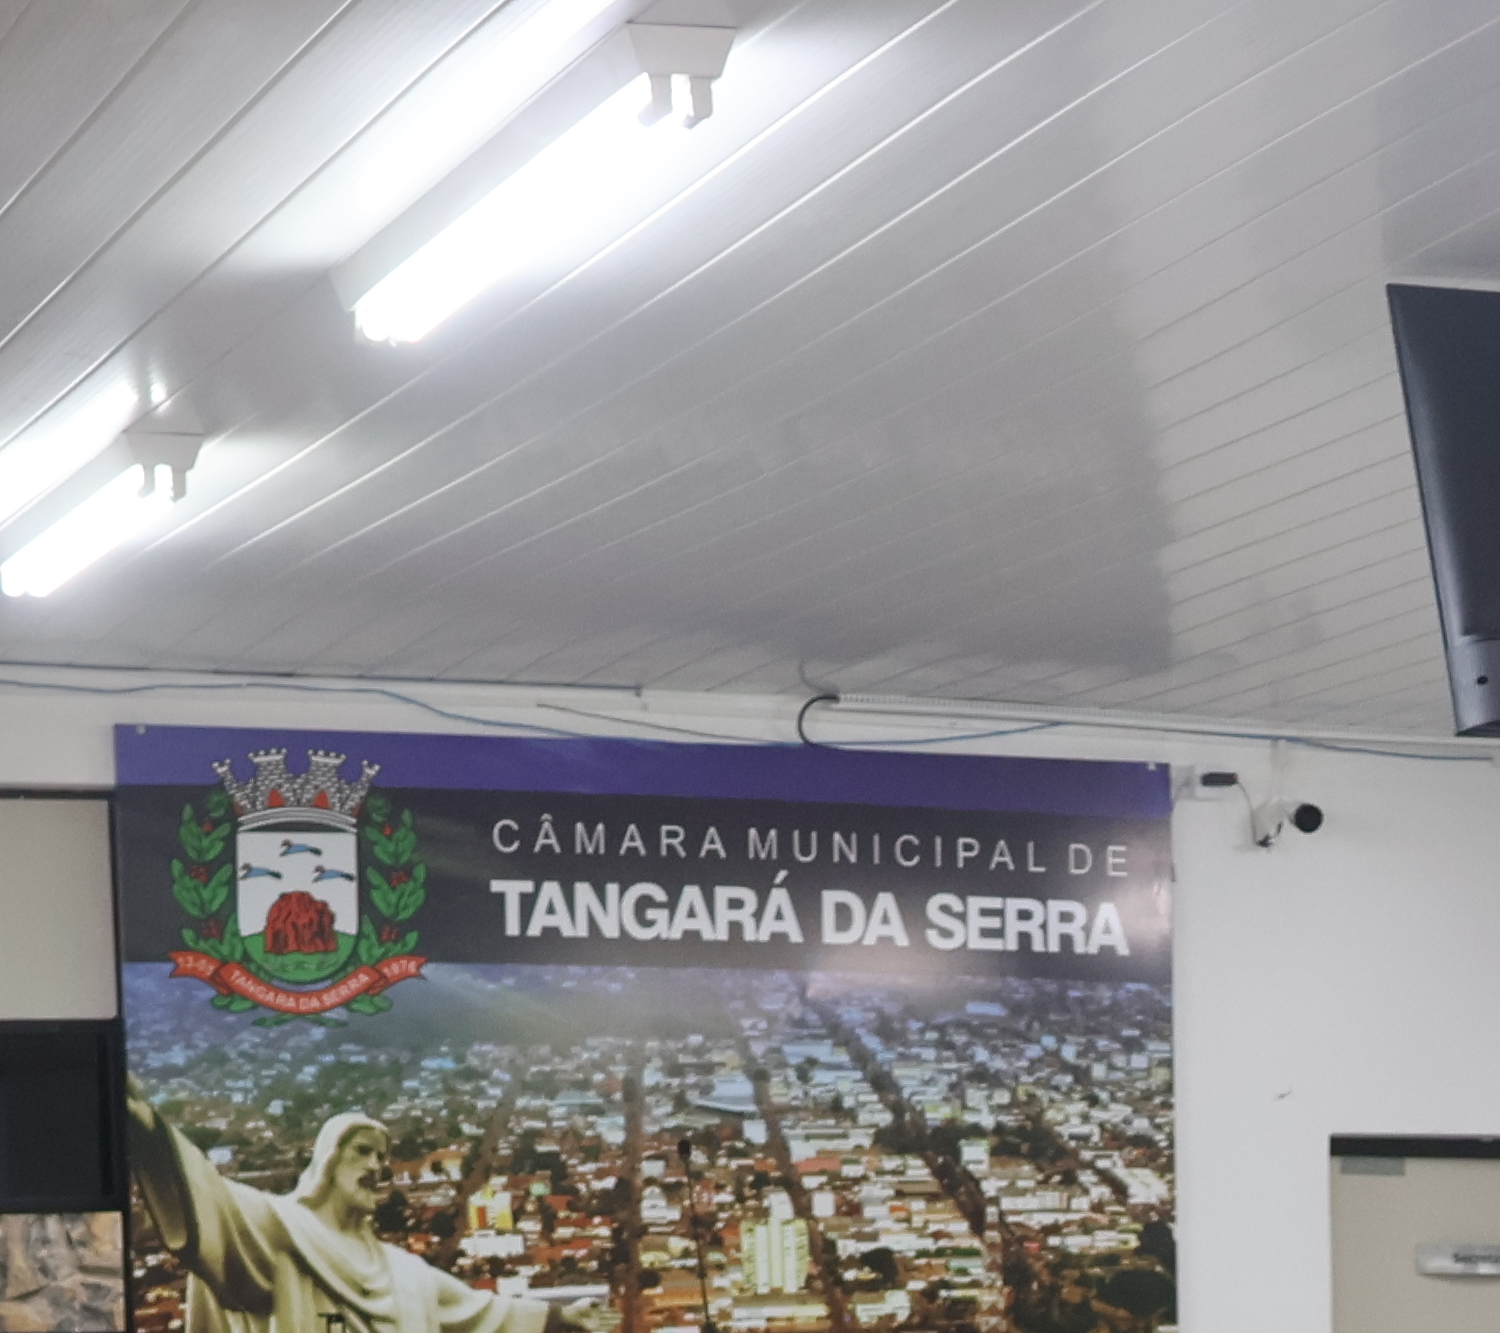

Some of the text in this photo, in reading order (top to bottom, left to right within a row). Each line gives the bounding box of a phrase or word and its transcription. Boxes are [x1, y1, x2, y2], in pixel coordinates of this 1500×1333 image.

[492, 810, 1130, 878] CÂMARA MUNICIPAL DE
[490, 869, 1130, 957] TANGARÁ DA SERRA
